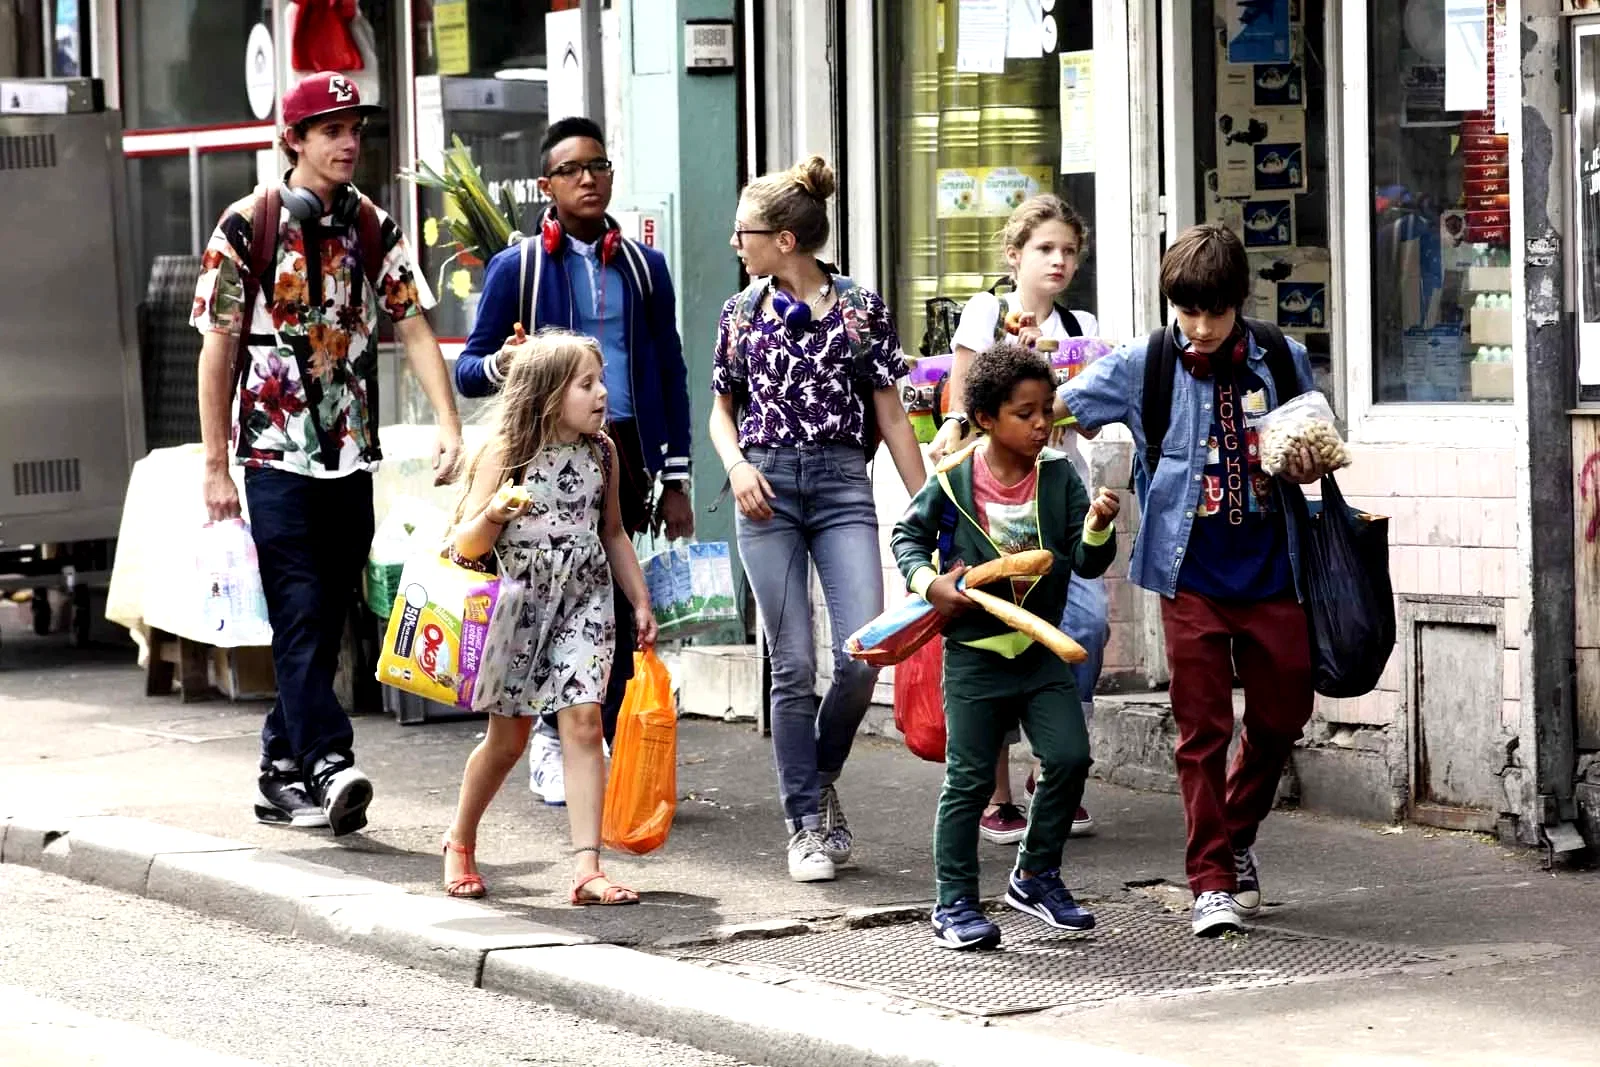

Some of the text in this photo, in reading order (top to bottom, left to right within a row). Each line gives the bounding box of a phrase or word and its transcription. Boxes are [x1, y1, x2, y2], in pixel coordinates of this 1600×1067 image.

[1218, 383, 1243, 525] HONG KONG
[423, 623, 444, 682] Okay
[467, 643, 479, 671] rêve
